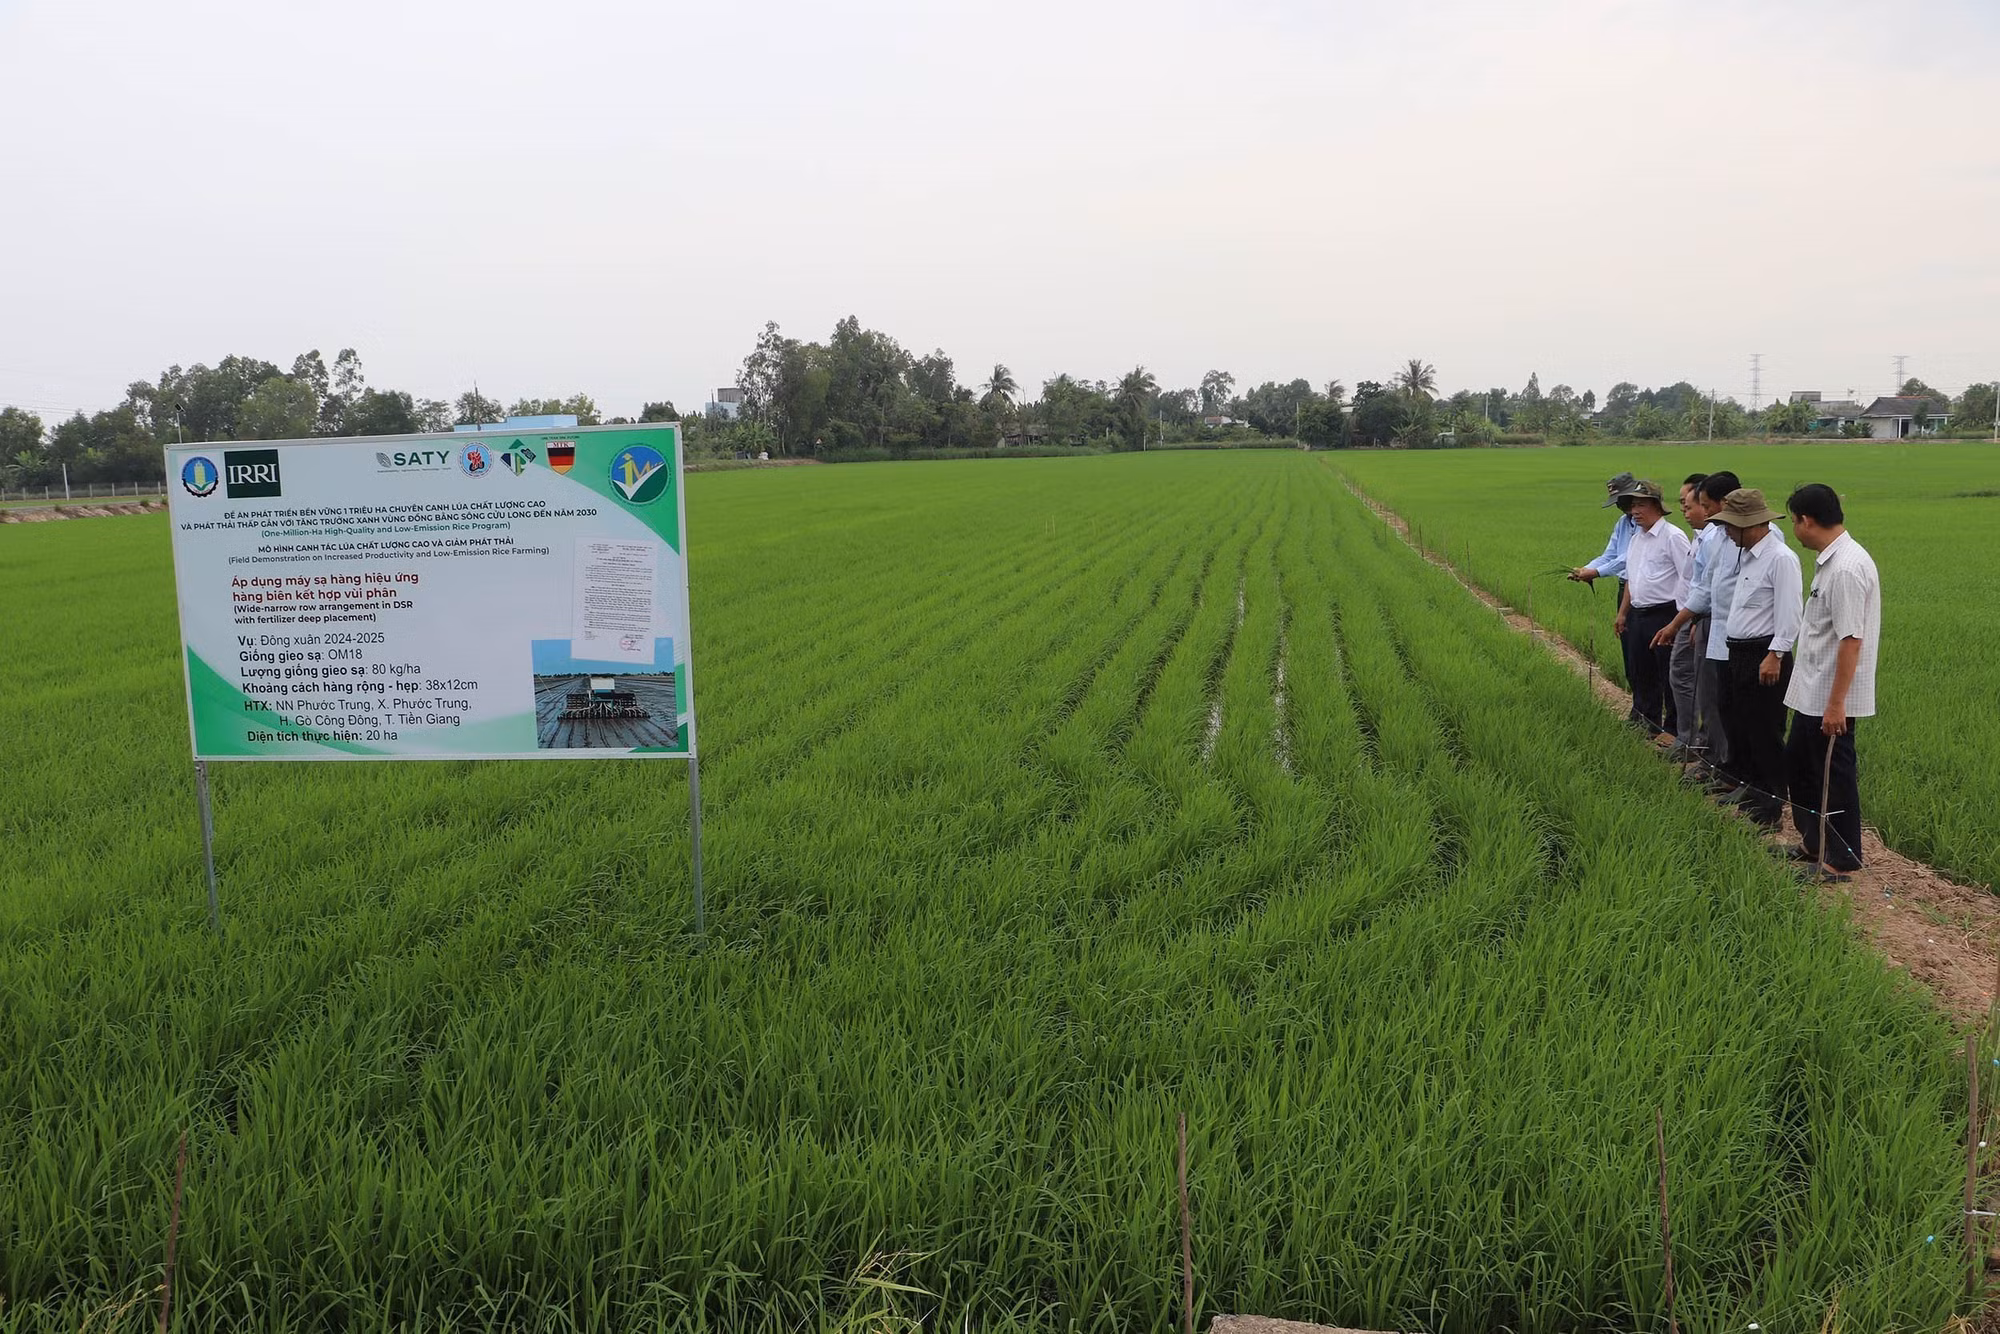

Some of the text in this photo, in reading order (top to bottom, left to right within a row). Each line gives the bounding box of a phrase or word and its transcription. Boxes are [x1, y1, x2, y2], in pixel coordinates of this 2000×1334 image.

[393, 450, 450, 466] SATY
[227, 463, 278, 485] IRRI
[425, 504, 450, 513] CANH
[527, 500, 546, 509] CAO
[356, 516, 380, 524] XANH
[262, 529, 323, 538] (One-Million-Ha
[324, 527, 375, 536] High-Quality
[394, 524, 450, 532] Low-Emission
[472, 522, 511, 531] Program)
[228, 556, 250, 565] (Field
[252, 554, 311, 563] Demonstration
[365, 551, 414, 559] Productivity
[433, 548, 490, 557] Low-Emission
[512, 547, 550, 555] Farming)
[231, 572, 419, 589] Áp dụng máy sạ hàng hiệu ứng
[232, 587, 397, 603] hàng biên kết hợp vùi phân
[234, 603, 297, 614] (Wide-narrow
[318, 602, 380, 612] arrangement
[382, 600, 391, 609] in
[393, 600, 413, 609] DSR
[234, 613, 376, 624] with fertilizer deep placement)
[238, 632, 385, 650] Vụ: Đông xuân 2024-2025
[239, 648, 363, 664] Giống gieo sạ: OM18
[240, 663, 421, 679] Lượng giống gieo sạ: 80 kg/ha
[291, 682, 320, 693] cách
[323, 681, 353, 694] hàng
[356, 681, 385, 694] rộng
[396, 680, 422, 693] hẹp:
[425, 679, 478, 690] 38x12cm
[244, 698, 472, 712] HTX: NN Phước Trung, X. Phước Trung,
[280, 712, 460, 728] H. Gò Công Đông, T. Tiền Giang
[247, 729, 398, 744] Diện tích thực hiện: 20 ha
